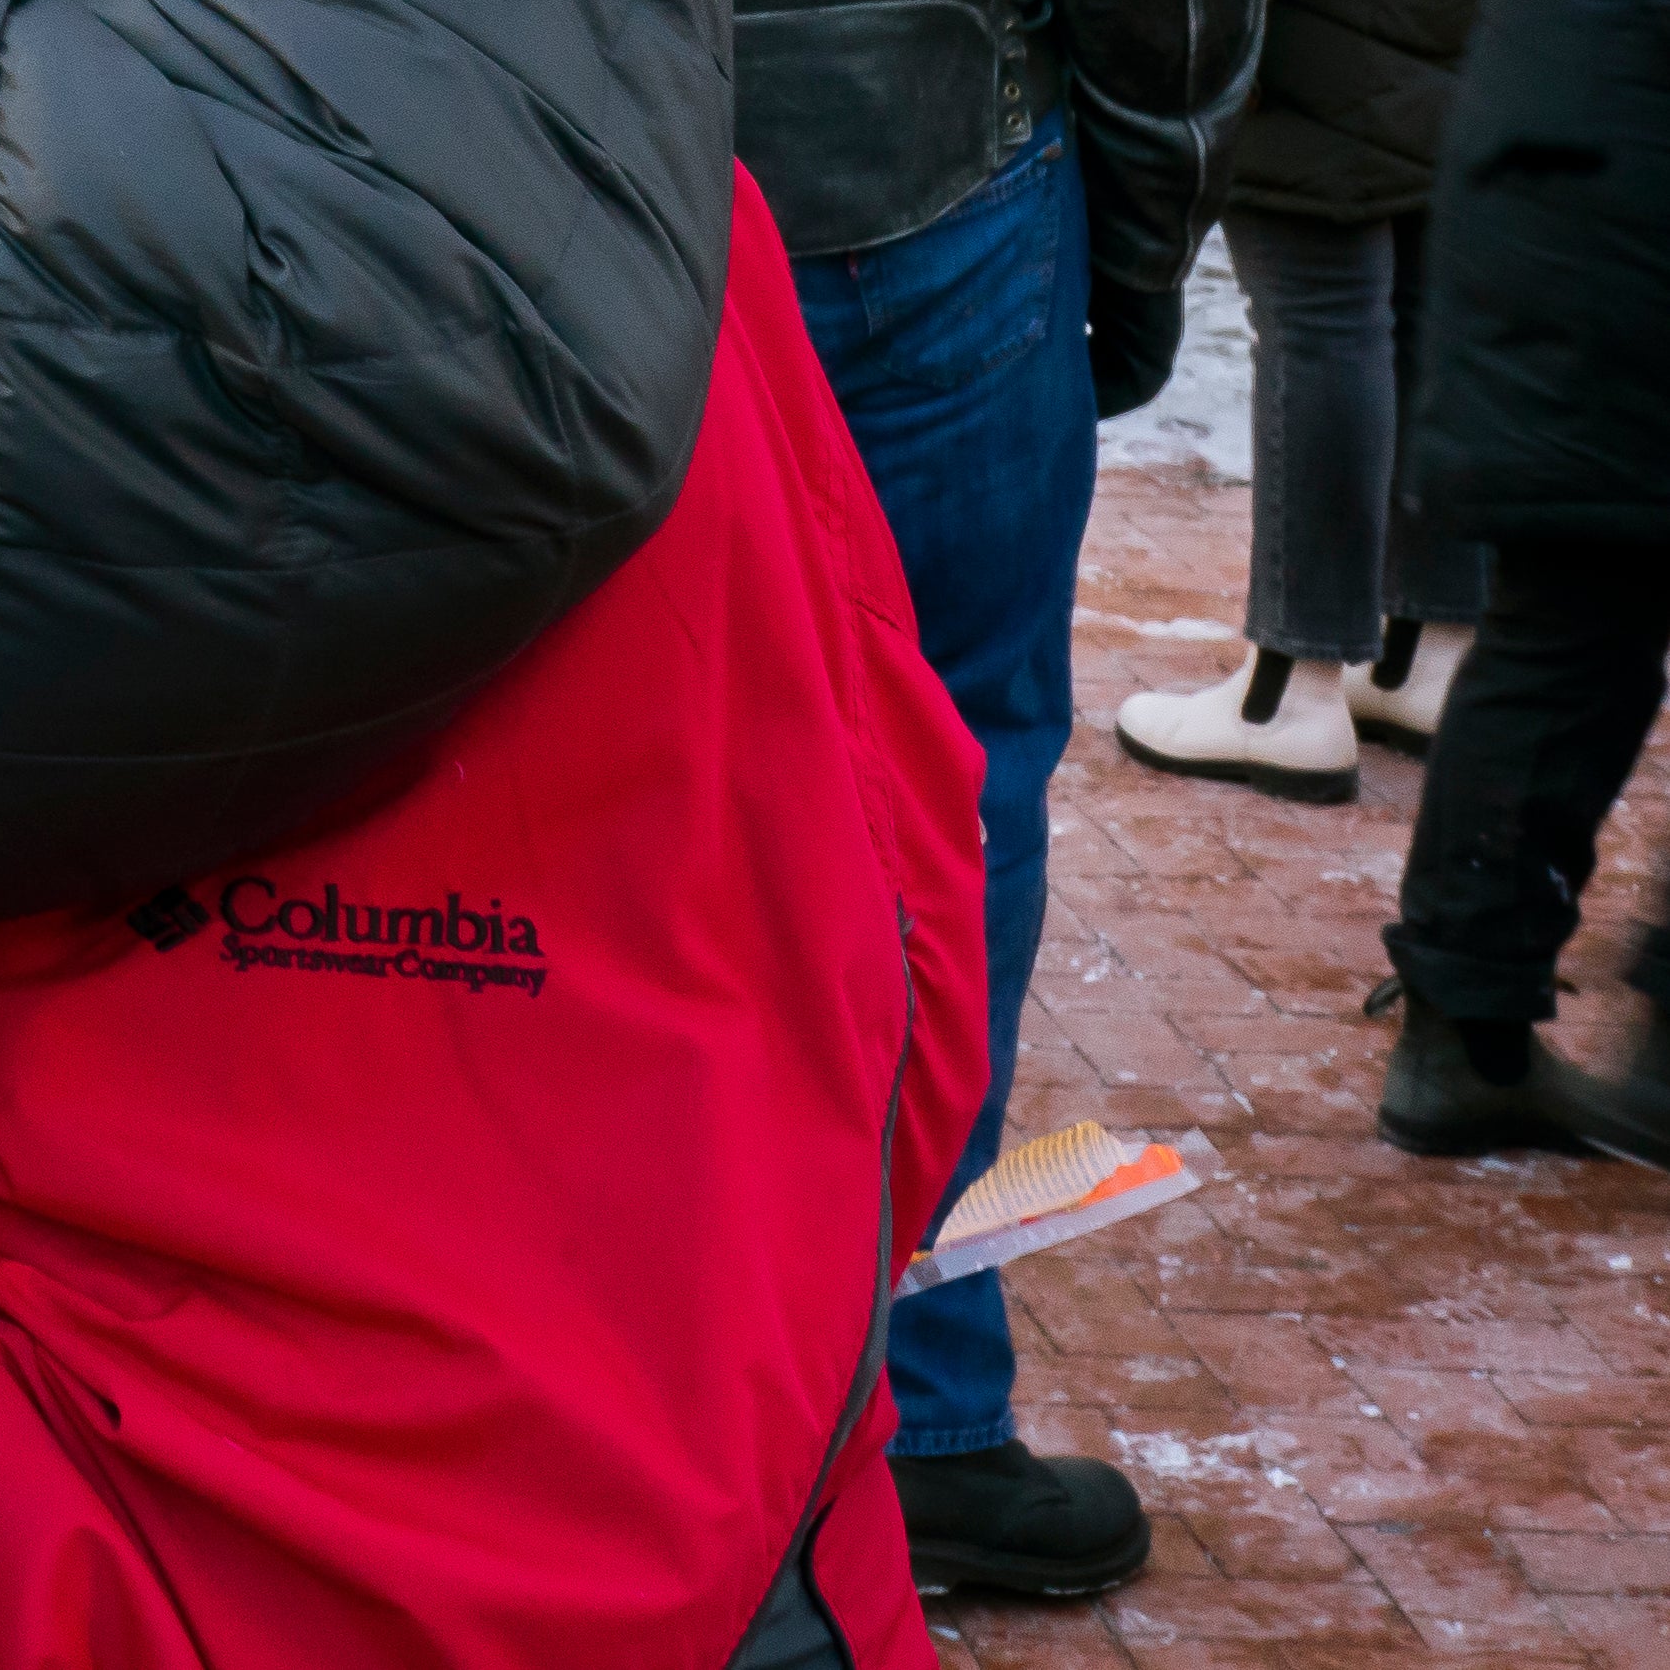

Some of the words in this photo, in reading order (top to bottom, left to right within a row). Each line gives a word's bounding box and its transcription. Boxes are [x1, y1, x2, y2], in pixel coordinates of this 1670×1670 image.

[219, 876, 545, 958] Columbia
[219, 933, 389, 978] Sportswear
[394, 949, 547, 998] Company
